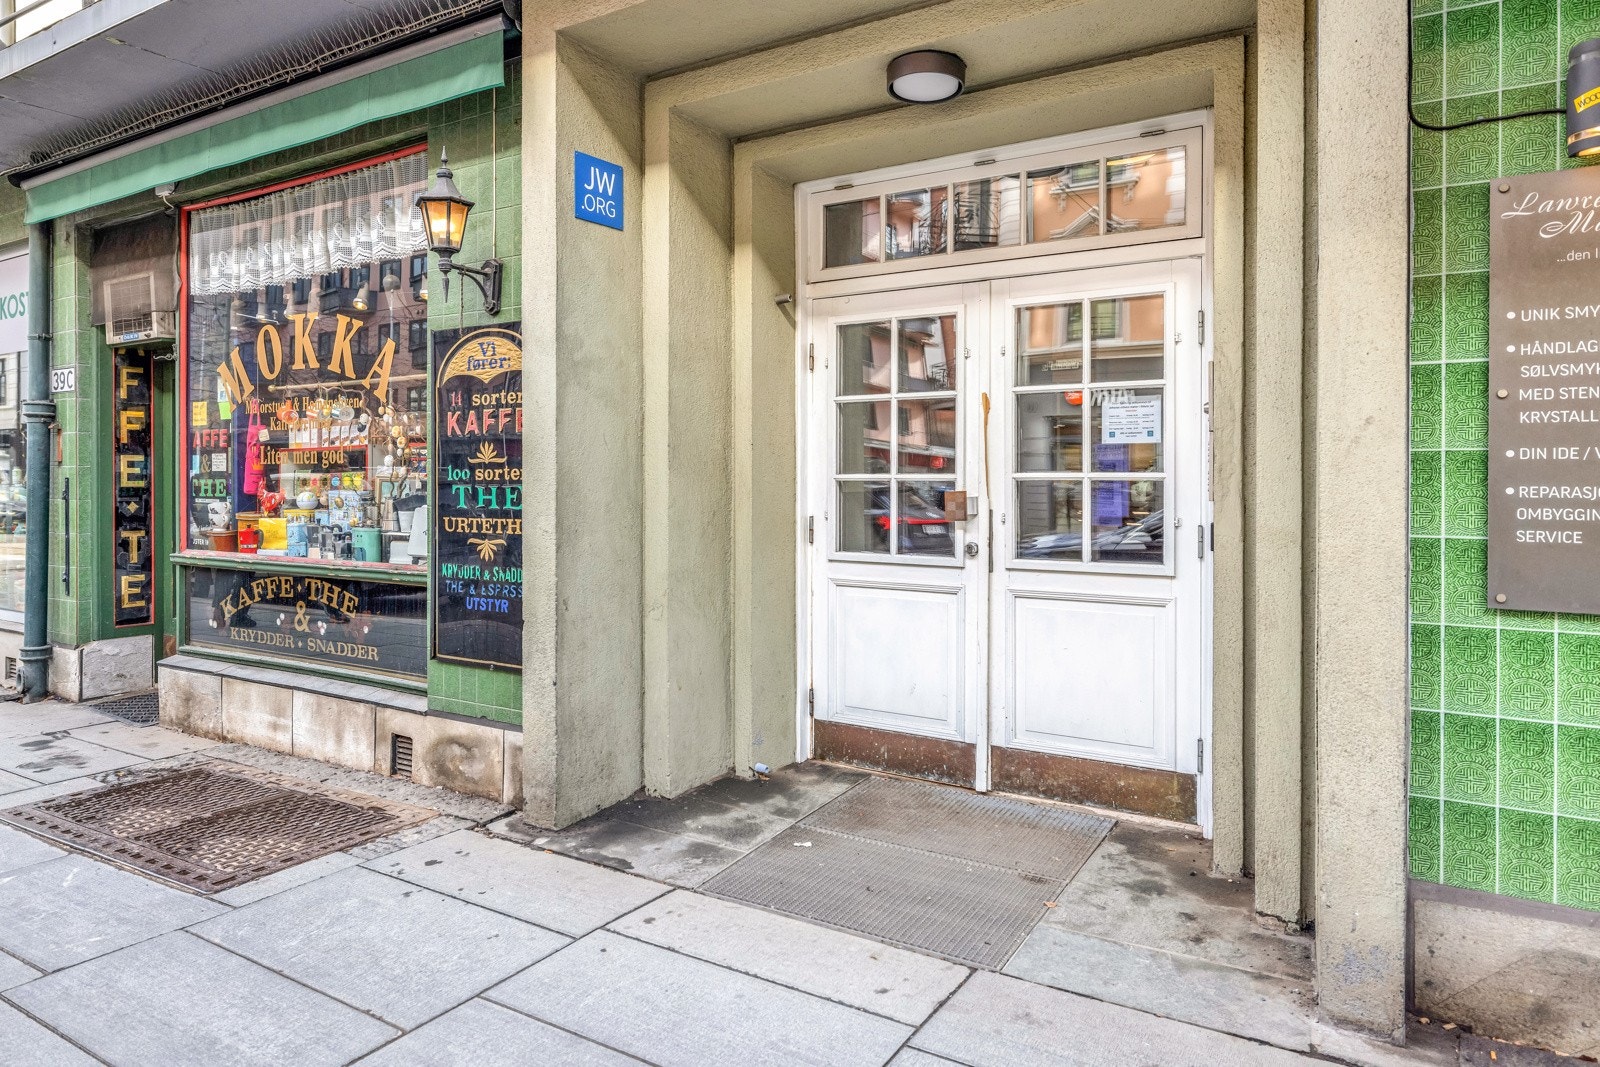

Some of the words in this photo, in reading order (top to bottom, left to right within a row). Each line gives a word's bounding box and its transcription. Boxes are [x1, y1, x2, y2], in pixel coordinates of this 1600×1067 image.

[584, 166, 615, 197] JW
[581, 193, 616, 218] .ORG
[0, 291, 29, 320] KOS
[1521, 307, 1560, 321] UNIK
[478, 341, 497, 357] Vi
[1520, 340, 1599, 355] HÅNDLAG
[216, 311, 396, 413] MOKKA
[467, 355, 511, 371] fører:
[53, 370, 74, 391] 39C
[1519, 387, 1555, 401] MED
[1559, 385, 1600, 400] STEN
[293, 396, 300, 412] &
[1520, 409, 1599, 424] KRYSTALL
[293, 449, 318, 465] men
[1519, 447, 1547, 460] DIN
[1552, 447, 1580, 460] IDE
[452, 484, 522, 510] THE
[1518, 486, 1600, 501] REPARASJ
[1516, 507, 1600, 521] OMBYGGIN
[1516, 530, 1583, 544] SERVICE
[483, 569, 491, 580] &
[445, 580, 465, 593] THE
[469, 584, 476, 595] &
[219, 576, 294, 621] KAFFE
[305, 577, 359, 619] THE
[466, 597, 509, 613] UTSTYR
[294, 600, 311, 633] &
[230, 626, 295, 649] KRYDDER
[307, 637, 380, 662] SNADDER
